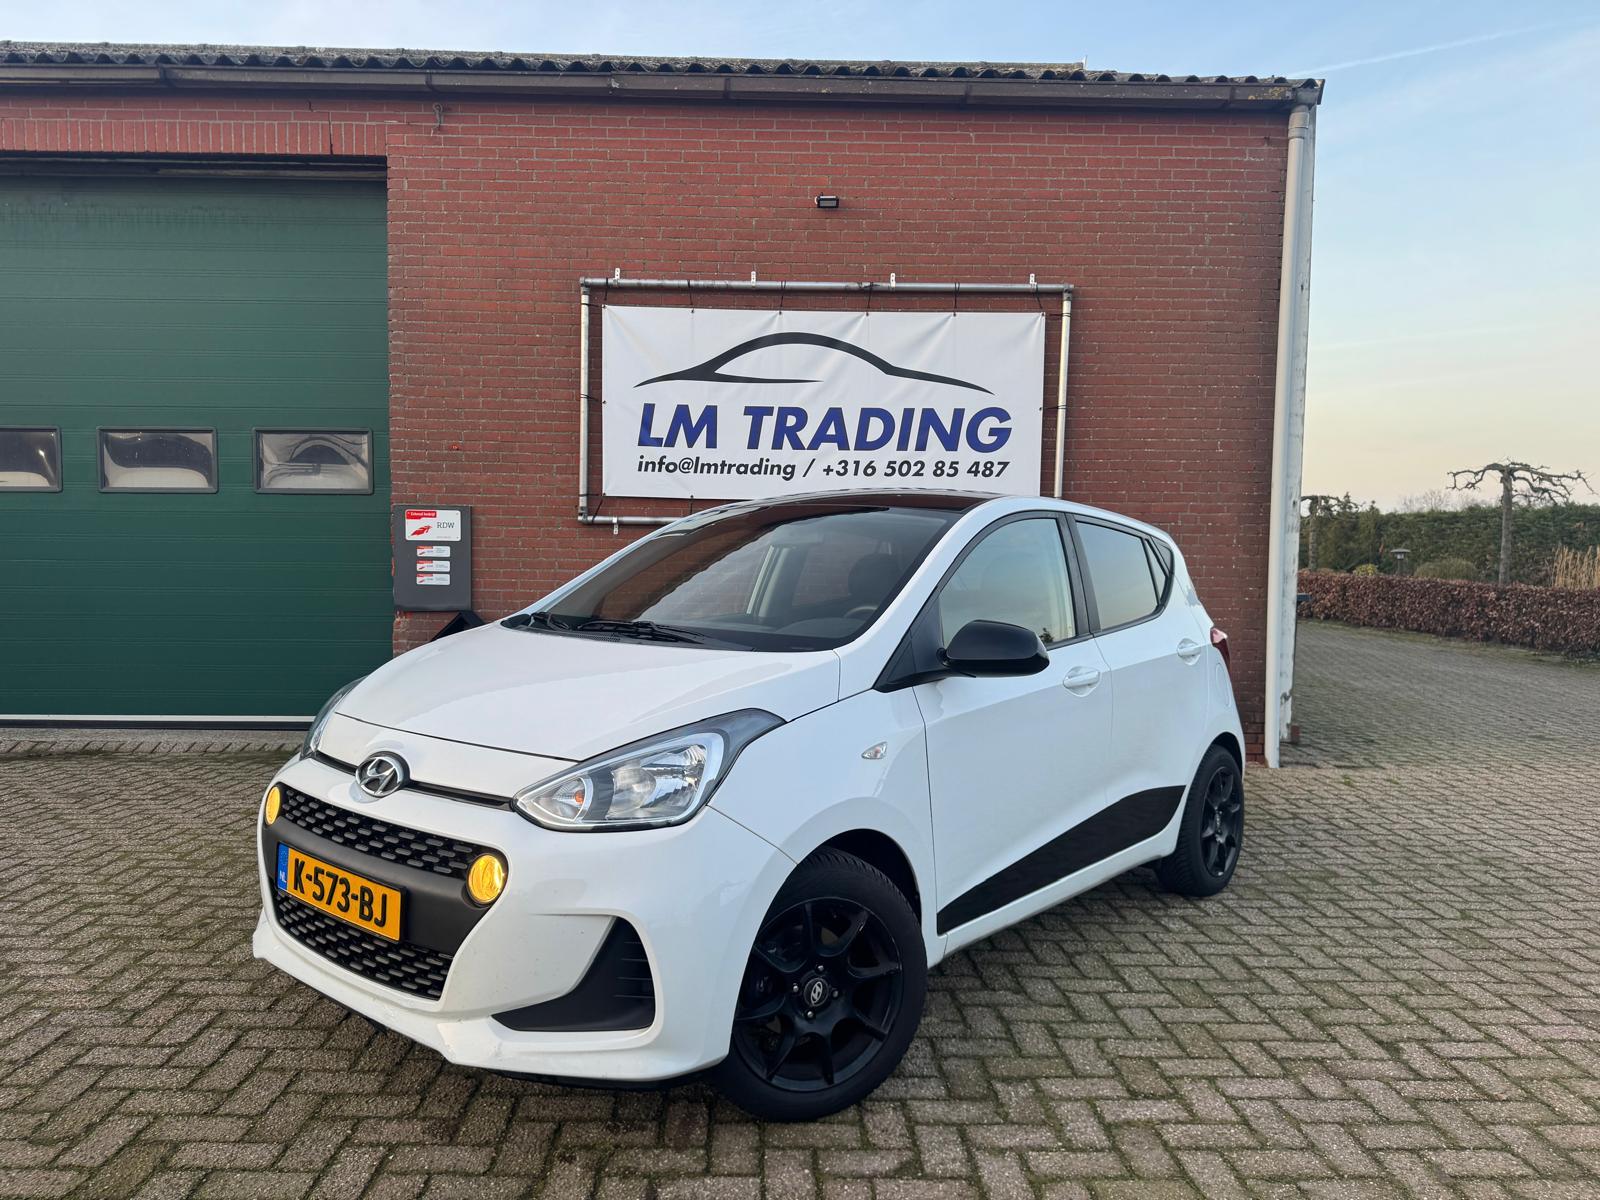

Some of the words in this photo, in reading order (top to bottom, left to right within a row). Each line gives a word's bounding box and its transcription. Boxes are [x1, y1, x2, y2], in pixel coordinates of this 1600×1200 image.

[637, 402, 718, 449] LM
[743, 405, 1012, 454] TRADING
[637, 455, 796, 481] info@lmtrading
[802, 458, 816, 478] /
[822, 459, 877, 477] +316
[883, 460, 926, 477] 502
[932, 460, 959, 477] 85
[966, 460, 1011, 478] 487
[436, 521, 455, 529] RDW
[279, 869, 287, 883] NL
[293, 857, 388, 928] K-573-BJ
